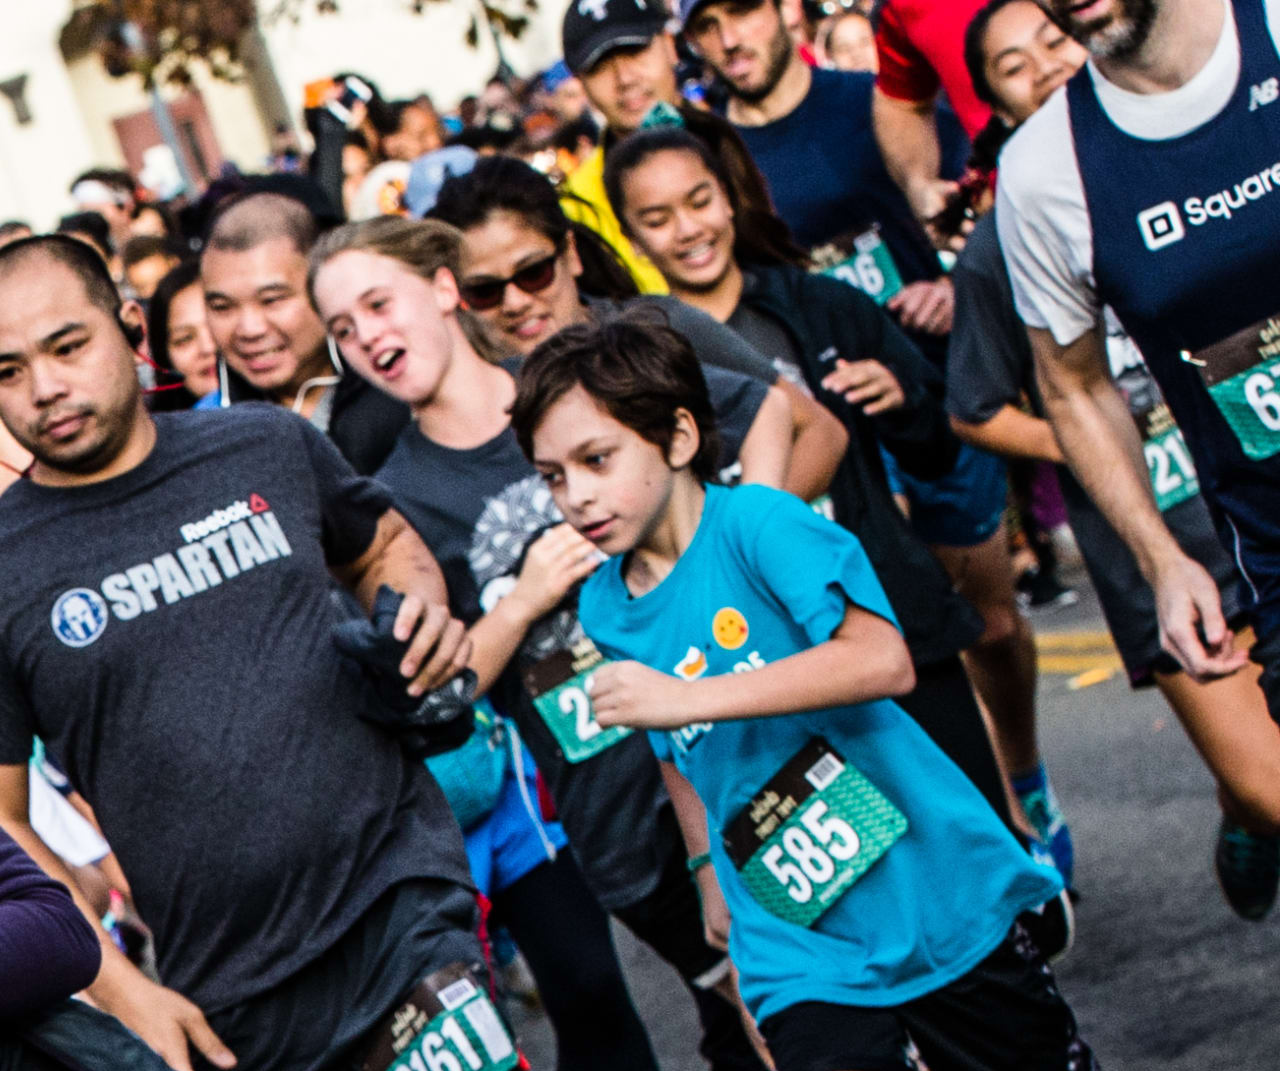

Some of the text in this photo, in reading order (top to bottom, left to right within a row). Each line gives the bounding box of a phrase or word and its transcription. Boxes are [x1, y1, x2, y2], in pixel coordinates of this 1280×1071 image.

[100, 511, 293, 621] SPARTAN
[180, 500, 253, 543] Reebok
[761, 799, 861, 904] 585
